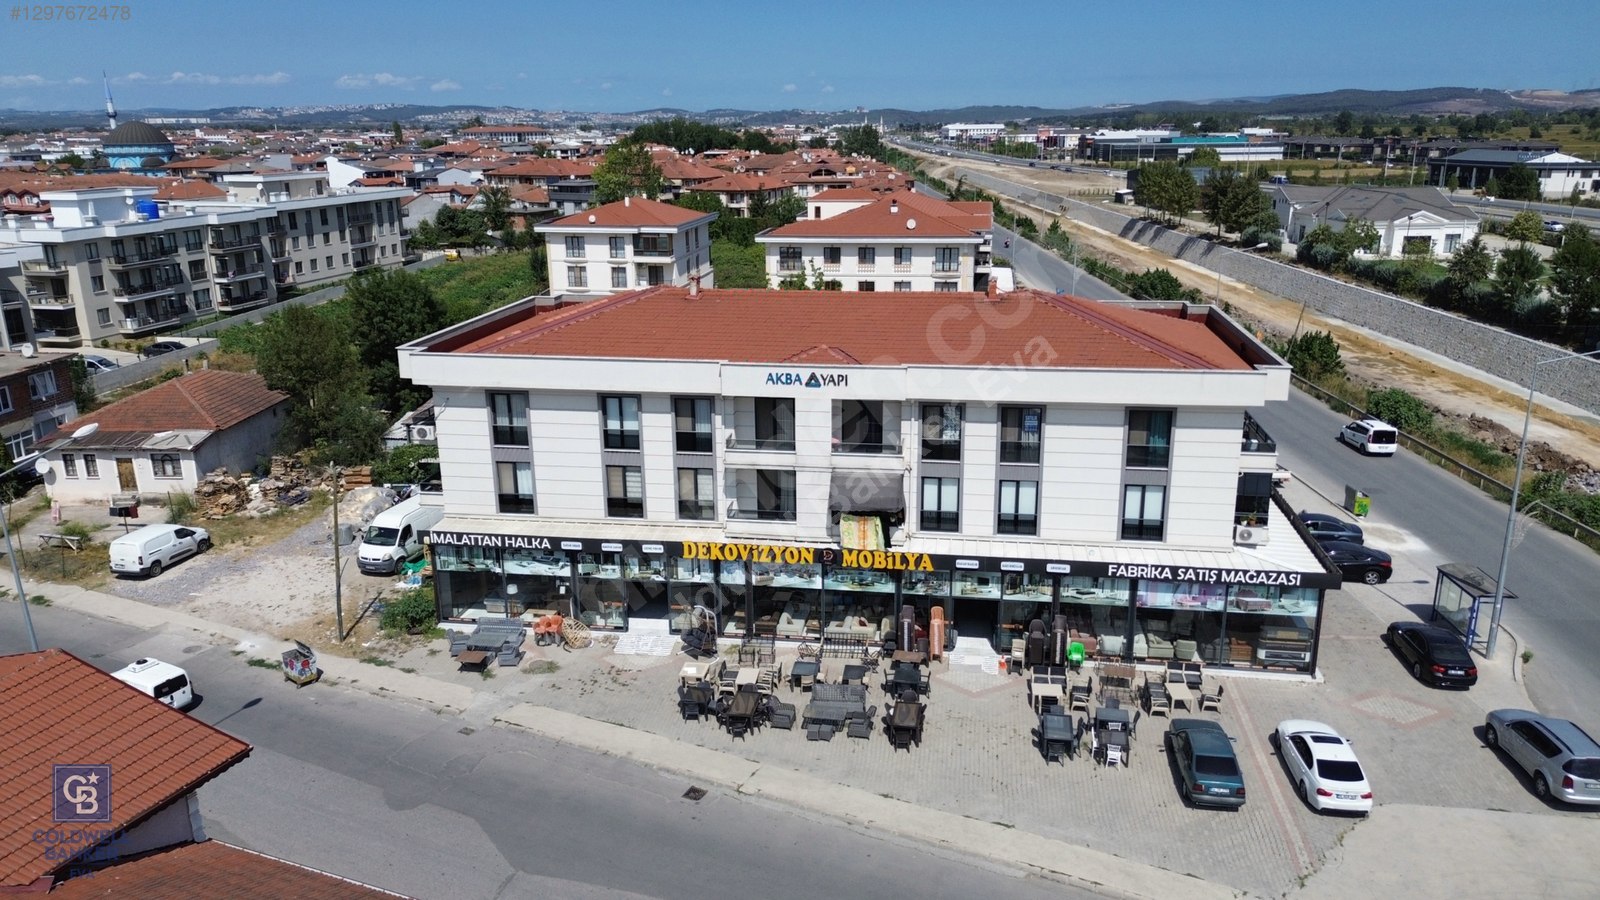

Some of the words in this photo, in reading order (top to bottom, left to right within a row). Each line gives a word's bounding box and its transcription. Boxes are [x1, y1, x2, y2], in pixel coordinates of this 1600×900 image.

[765, 372, 803, 386] AKBA
[820, 374, 849, 387] YAPI
[429, 530, 502, 547] İMALATTAN
[504, 536, 551, 550] HALKA
[1107, 563, 1172, 580] FABRİKA
[1177, 567, 1218, 585] SATIŞ
[1220, 569, 1301, 586] MAĞAZASI
